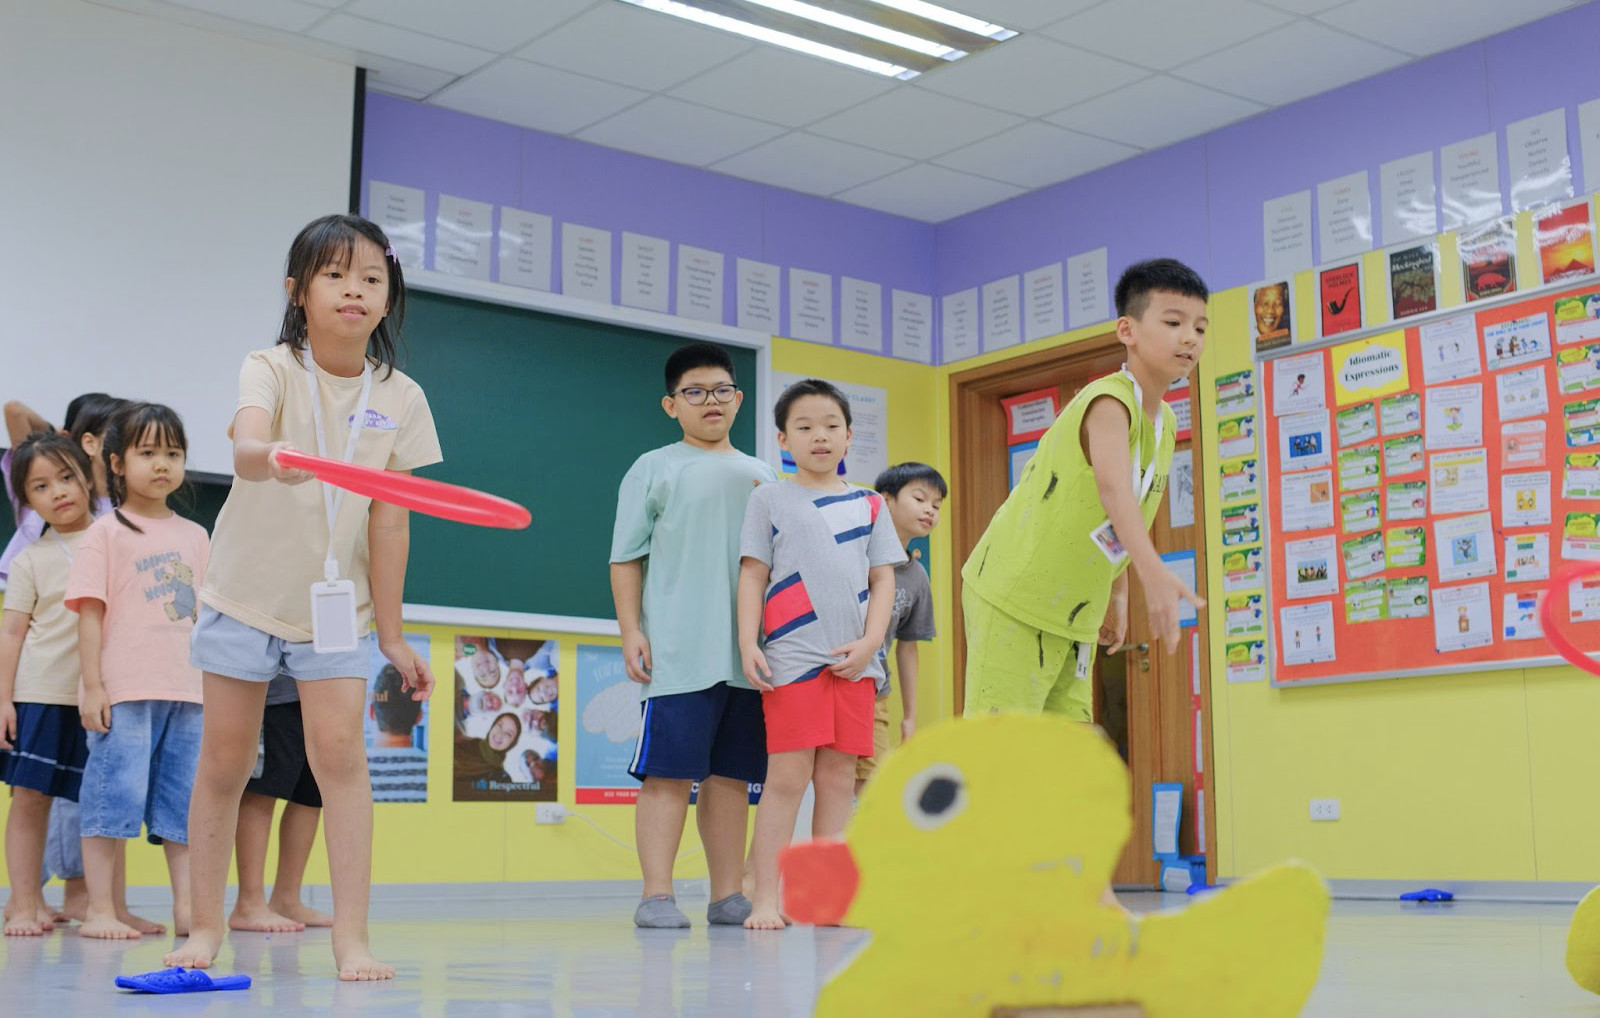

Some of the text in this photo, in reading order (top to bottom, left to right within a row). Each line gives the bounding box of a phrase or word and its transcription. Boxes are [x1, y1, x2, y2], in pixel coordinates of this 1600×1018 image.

[1349, 350, 1392, 366] Idiomatic
[1344, 364, 1399, 382] Expressions
[489, 780, 541, 793] Respectful
